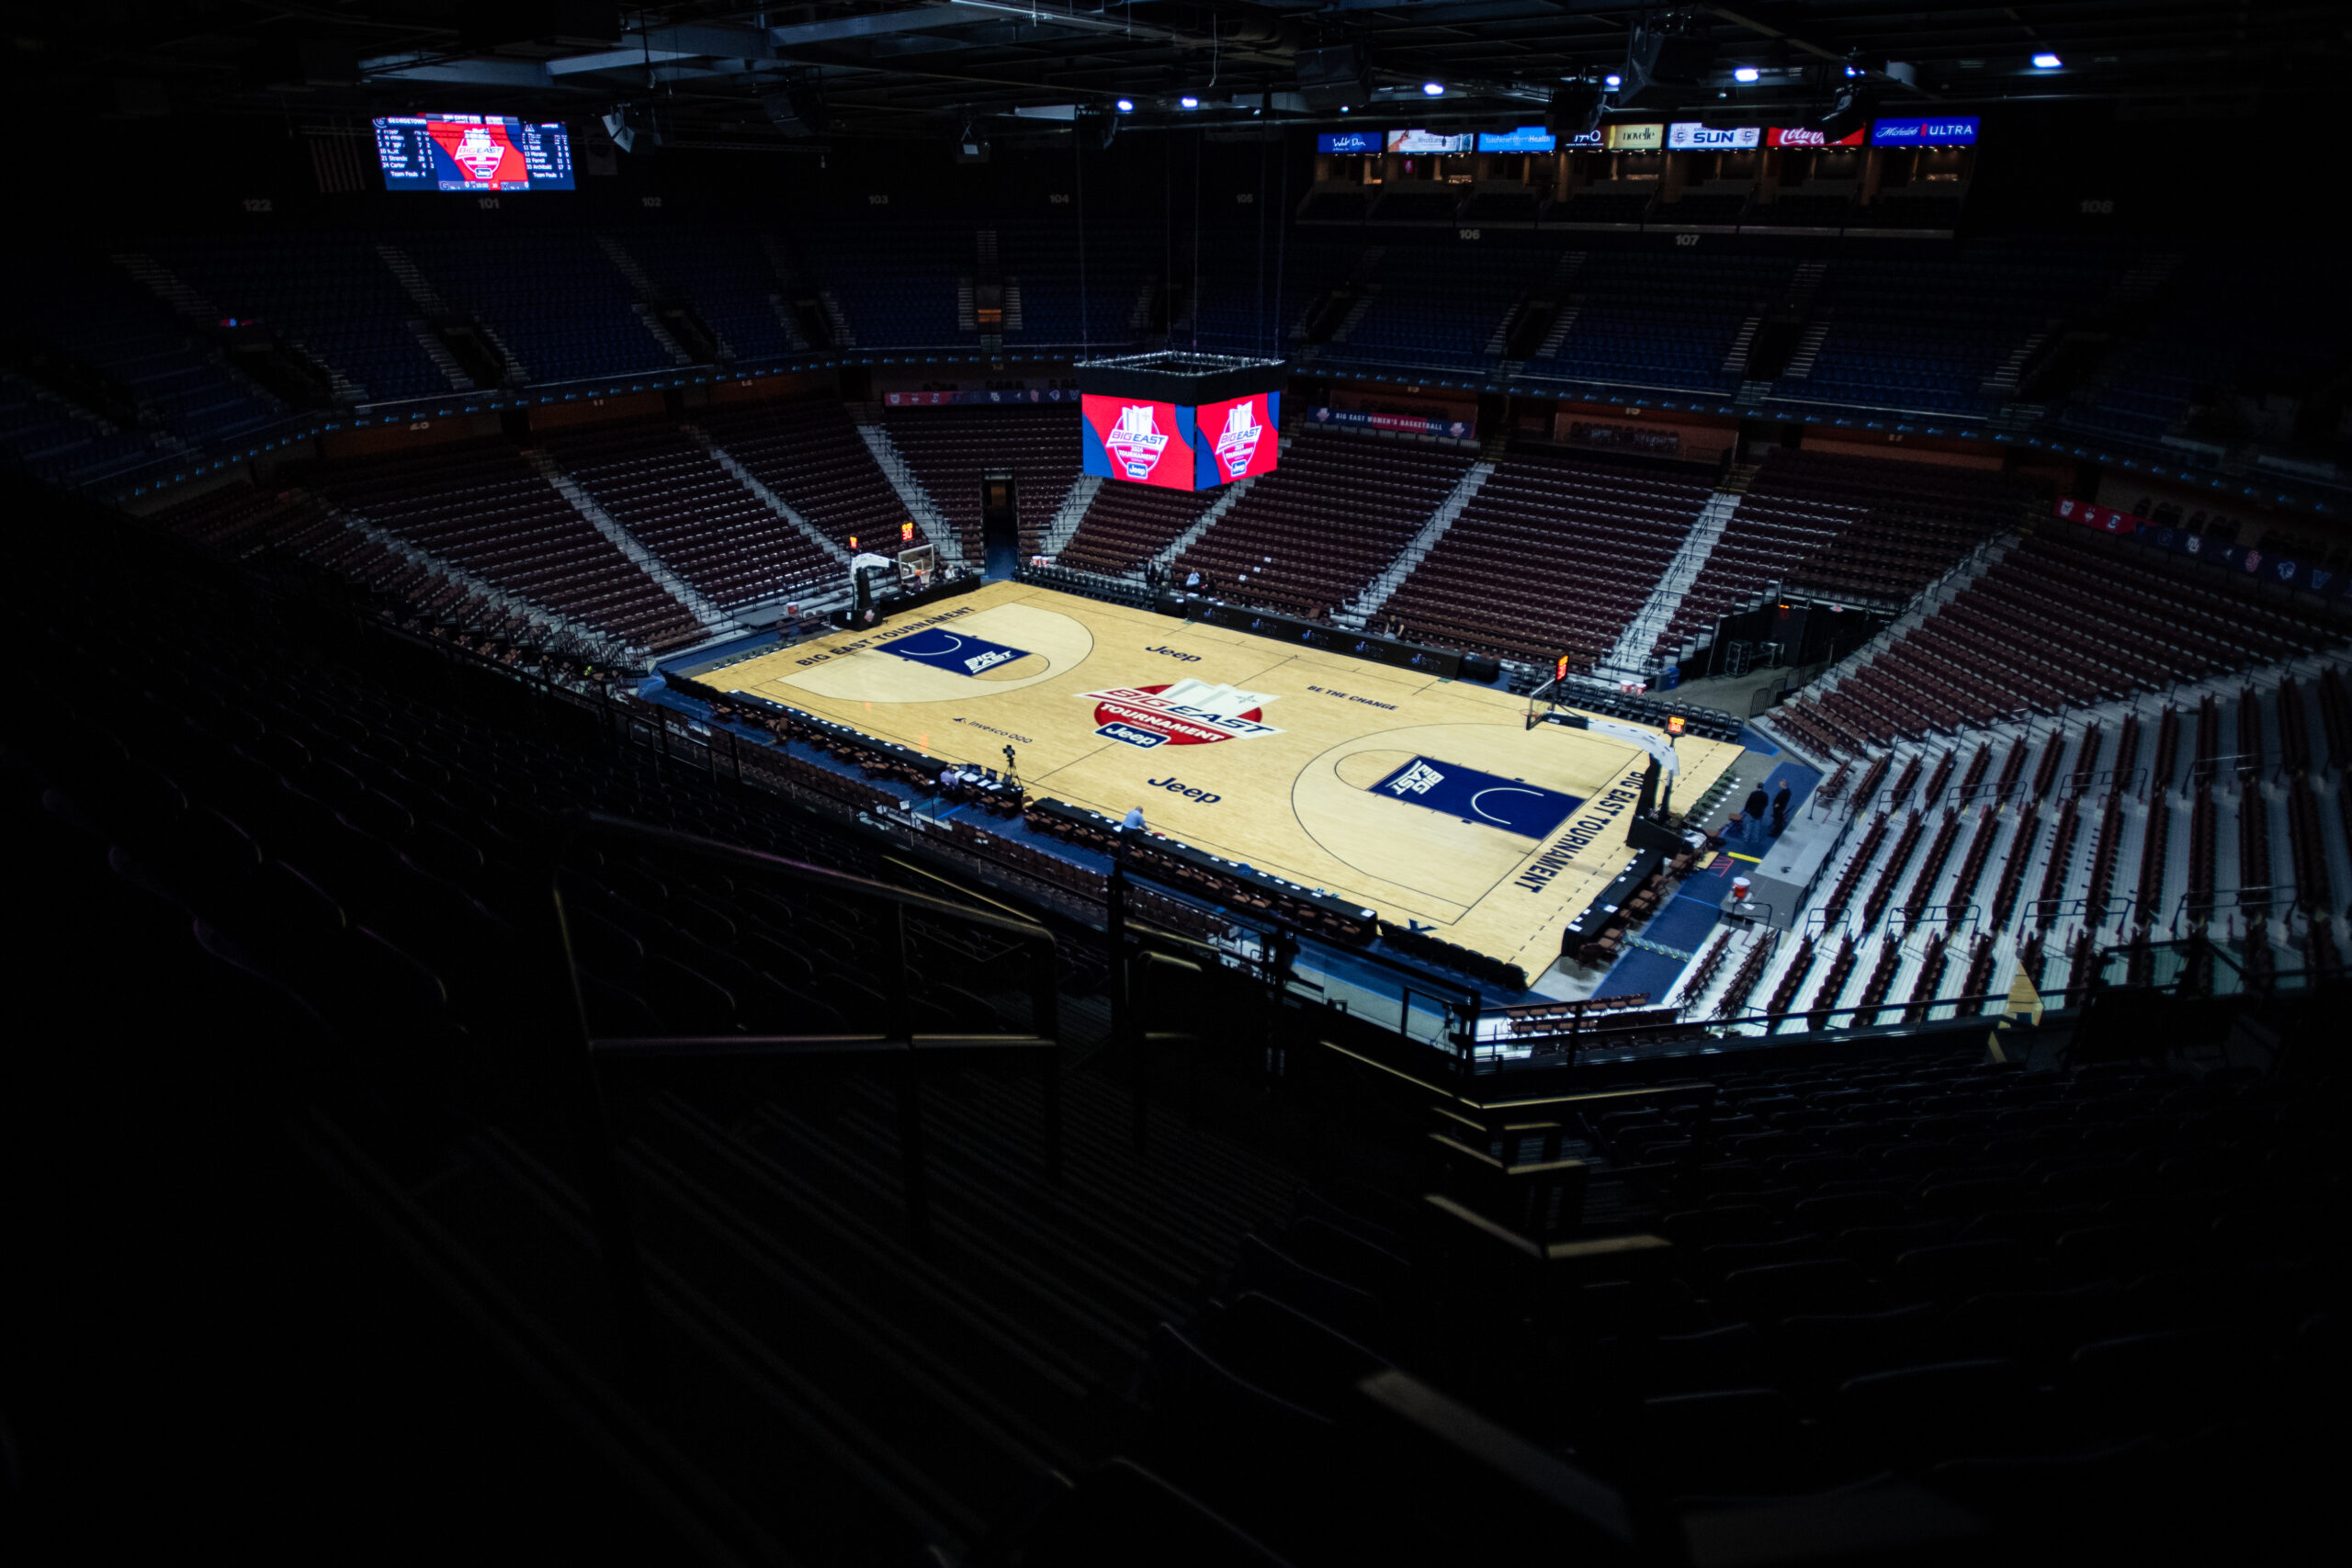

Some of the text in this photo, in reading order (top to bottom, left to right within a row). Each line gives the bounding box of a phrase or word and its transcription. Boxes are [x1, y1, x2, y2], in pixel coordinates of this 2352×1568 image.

[1693, 131, 1735, 143] SUN
[1929, 125, 1973, 135] ULTRA
[242, 197, 273, 213] 122
[478, 197, 500, 209] 101
[640, 196, 662, 208] 102
[867, 194, 888, 205] 103
[1048, 193, 1069, 205] 104
[2079, 199, 2116, 214] 108
[1458, 228, 1481, 241] 106
[1675, 233, 1701, 246] 107
[1349, 413, 1365, 422] EAST
[1367, 415, 1397, 425] WOMEN'S
[1399, 418, 1442, 431] BASKETBALL
[1112, 431, 1165, 446] BIG EAST
[1221, 427, 1261, 445] BIG EAST
[1118, 449, 1158, 461] TOURNAMENT
[1129, 464, 1146, 475] Jeep
[902, 528, 913, 541] 30
[796, 606, 976, 667] BIG EAST TOURNAMENT
[964, 650, 998, 669] BIG
[1146, 646, 1202, 662] Jeep
[1306, 684, 1398, 711] BE THE CHANGE
[1106, 689, 1274, 733] BIG EAST
[1100, 703, 1227, 742] TOURNAMENT
[1105, 727, 1157, 747] Jeep
[1416, 768, 1445, 795] BIG
[1148, 776, 1221, 806] Jeep
[1596, 788, 1637, 818] EAST
[1514, 818, 1611, 894] TOURNAMENT
